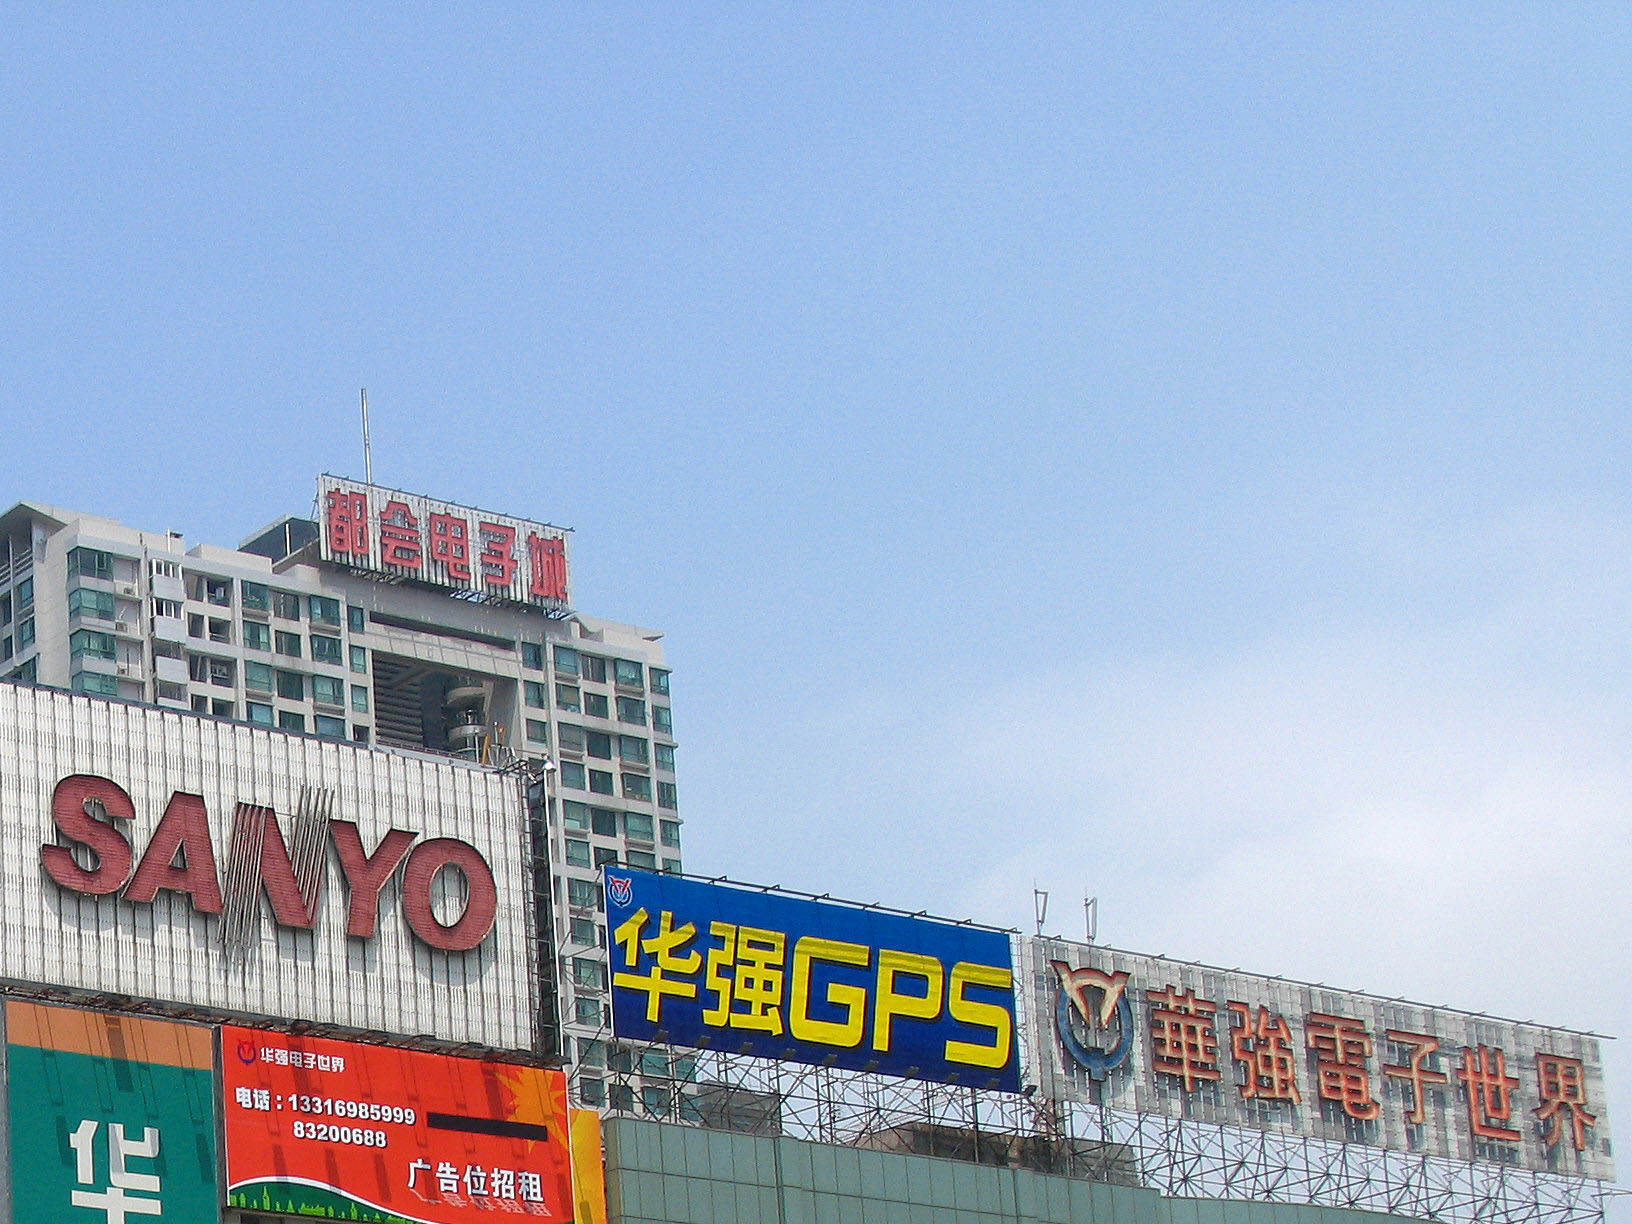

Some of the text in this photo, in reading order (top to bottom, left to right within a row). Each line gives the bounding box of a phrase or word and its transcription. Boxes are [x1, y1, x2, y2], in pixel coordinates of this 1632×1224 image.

[327, 488, 569, 601] 都会电子城
[41, 774, 497, 952] SANYO
[611, 905, 1014, 1070] 华强GPS
[259, 1047, 346, 1073] 华强电子世界
[293, 1120, 388, 1148] 83200688
[407, 1158, 545, 1203] 广告位招租
